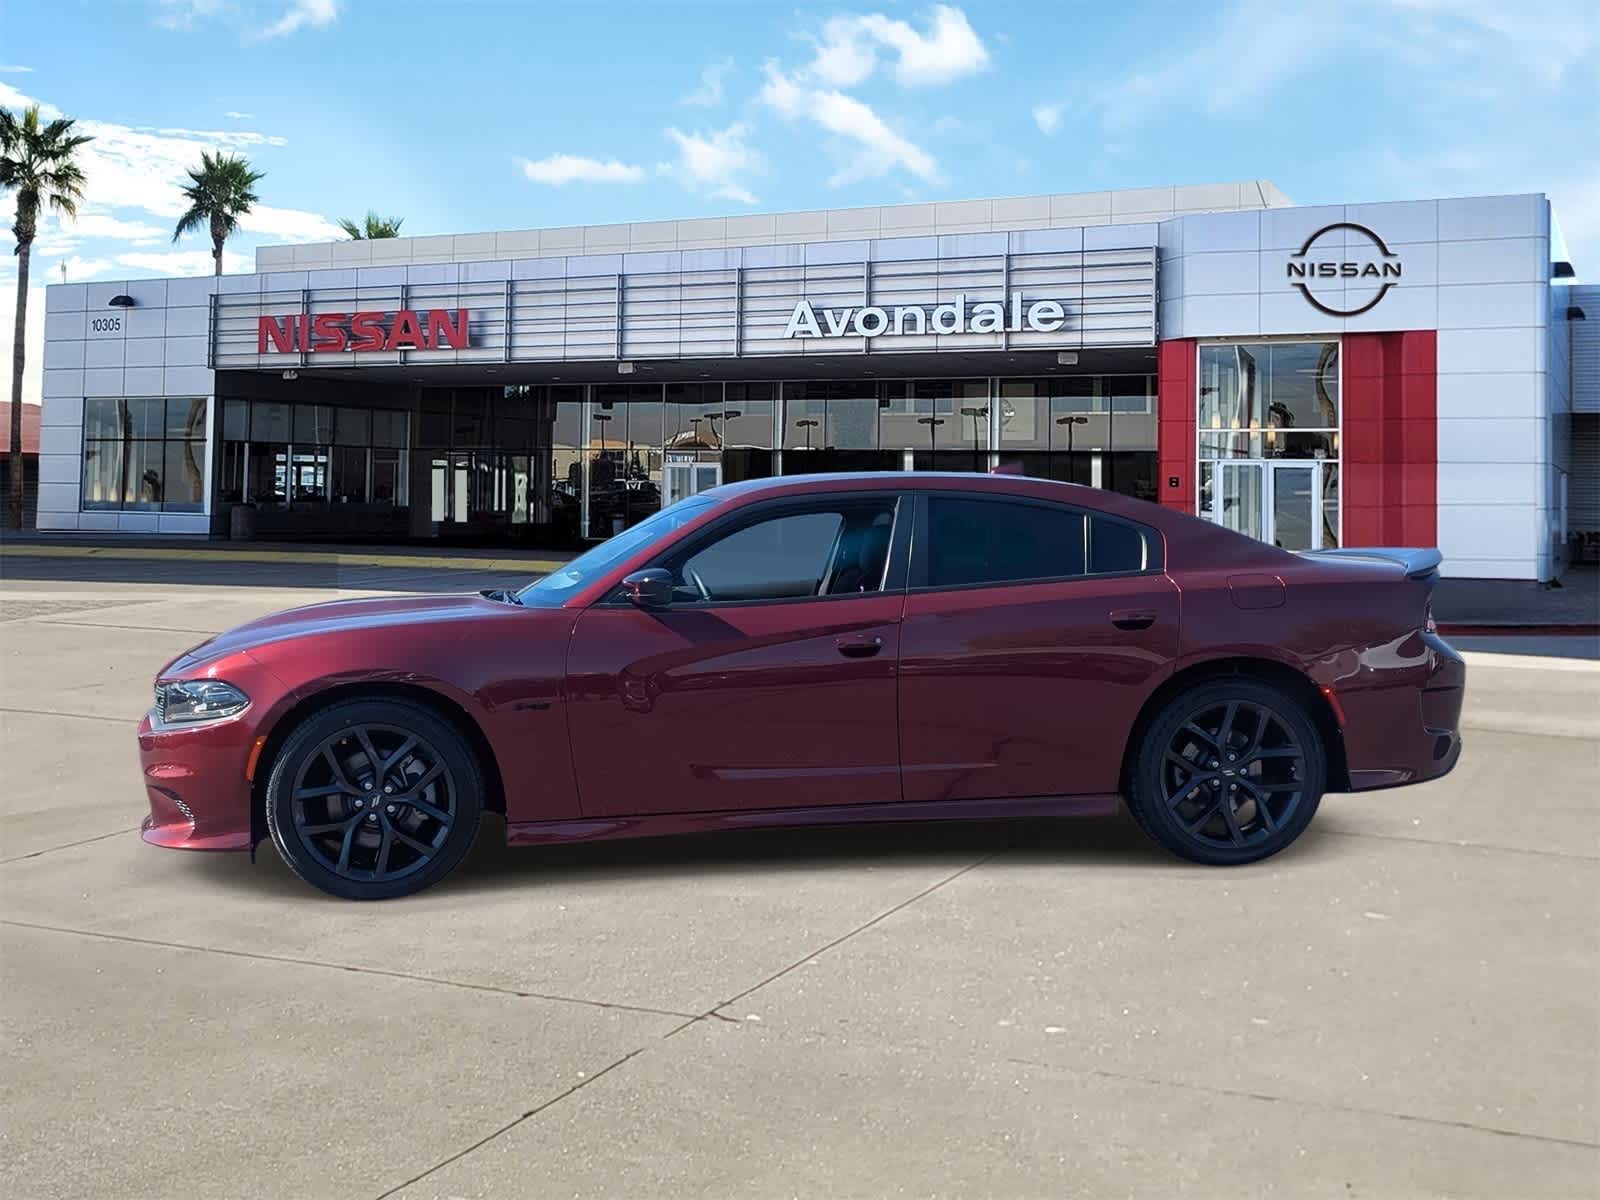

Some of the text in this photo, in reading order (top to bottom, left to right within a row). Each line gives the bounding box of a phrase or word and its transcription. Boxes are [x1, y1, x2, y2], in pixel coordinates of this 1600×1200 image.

[1286, 262, 1402, 278] NISSAN
[91, 318, 121, 332] 10305
[783, 291, 1065, 339] Avondale
[258, 308, 469, 354] NISSAN
